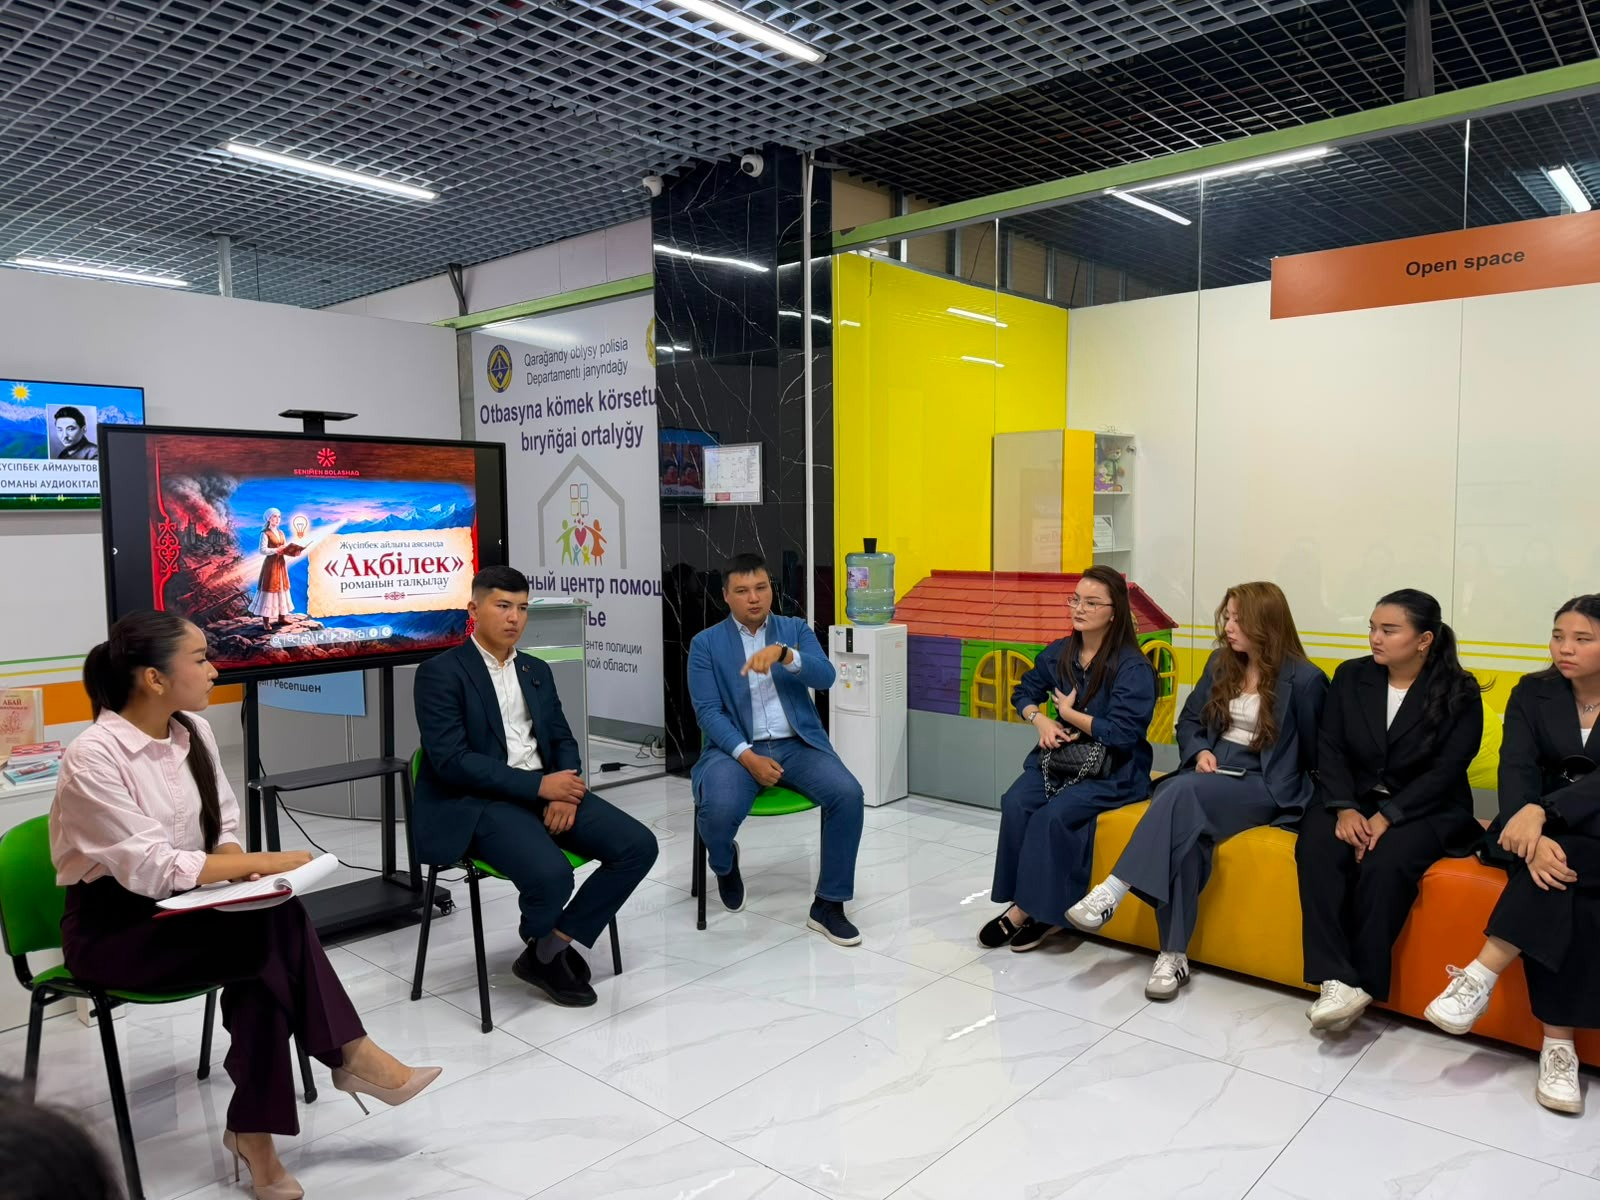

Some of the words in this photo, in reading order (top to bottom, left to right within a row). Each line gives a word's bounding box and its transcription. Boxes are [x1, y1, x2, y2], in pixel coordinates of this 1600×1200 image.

[1405, 259, 1457, 277] Open
[1463, 250, 1525, 271] space
[524, 350, 568, 367] Qarağandy
[570, 344, 598, 361] oblysy
[600, 338, 628, 354] polisia
[583, 358, 628, 381] janyndağy
[480, 403, 542, 425] Otbasyna
[546, 392, 594, 416] kömek
[599, 385, 657, 411] körsetu
[581, 420, 644, 450] ortalyğy
[0, 463, 40, 471] ҮСІПБЕК
[42, 462, 98, 472] АЙМАУЫТОВ
[0, 480, 37, 488] ОМАНЫ
[324, 551, 464, 579] «Ақбілек»
[340, 579, 394, 593] романын
[398, 576, 449, 588] талқылау
[527, 570, 556, 591] ный
[561, 577, 605, 599] центр
[585, 610, 606, 627] ье
[585, 640, 604, 651] енте
[606, 641, 642, 656] полиции
[587, 657, 601, 669] кой
[603, 658, 638, 673] области
[274, 680, 321, 693] Ресепшен
